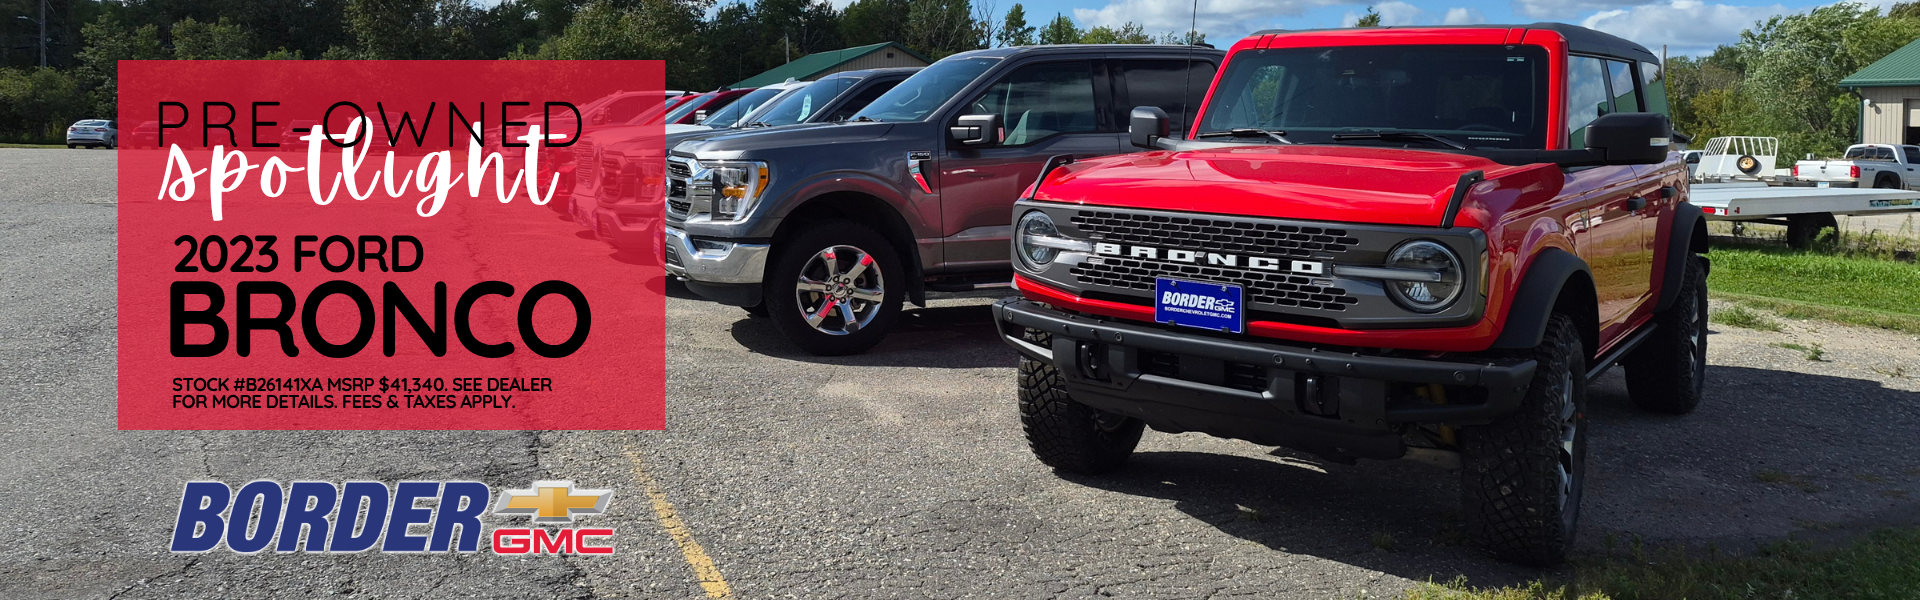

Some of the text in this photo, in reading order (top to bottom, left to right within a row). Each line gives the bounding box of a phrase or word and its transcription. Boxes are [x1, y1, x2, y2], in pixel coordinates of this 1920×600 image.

[1095, 242, 1323, 275] BRONCO
[1162, 291, 1215, 310] BORDER
[1164, 306, 1232, 319] BORDERCHEVROLETGMC.COM
[1214, 305, 1235, 313] GMC
